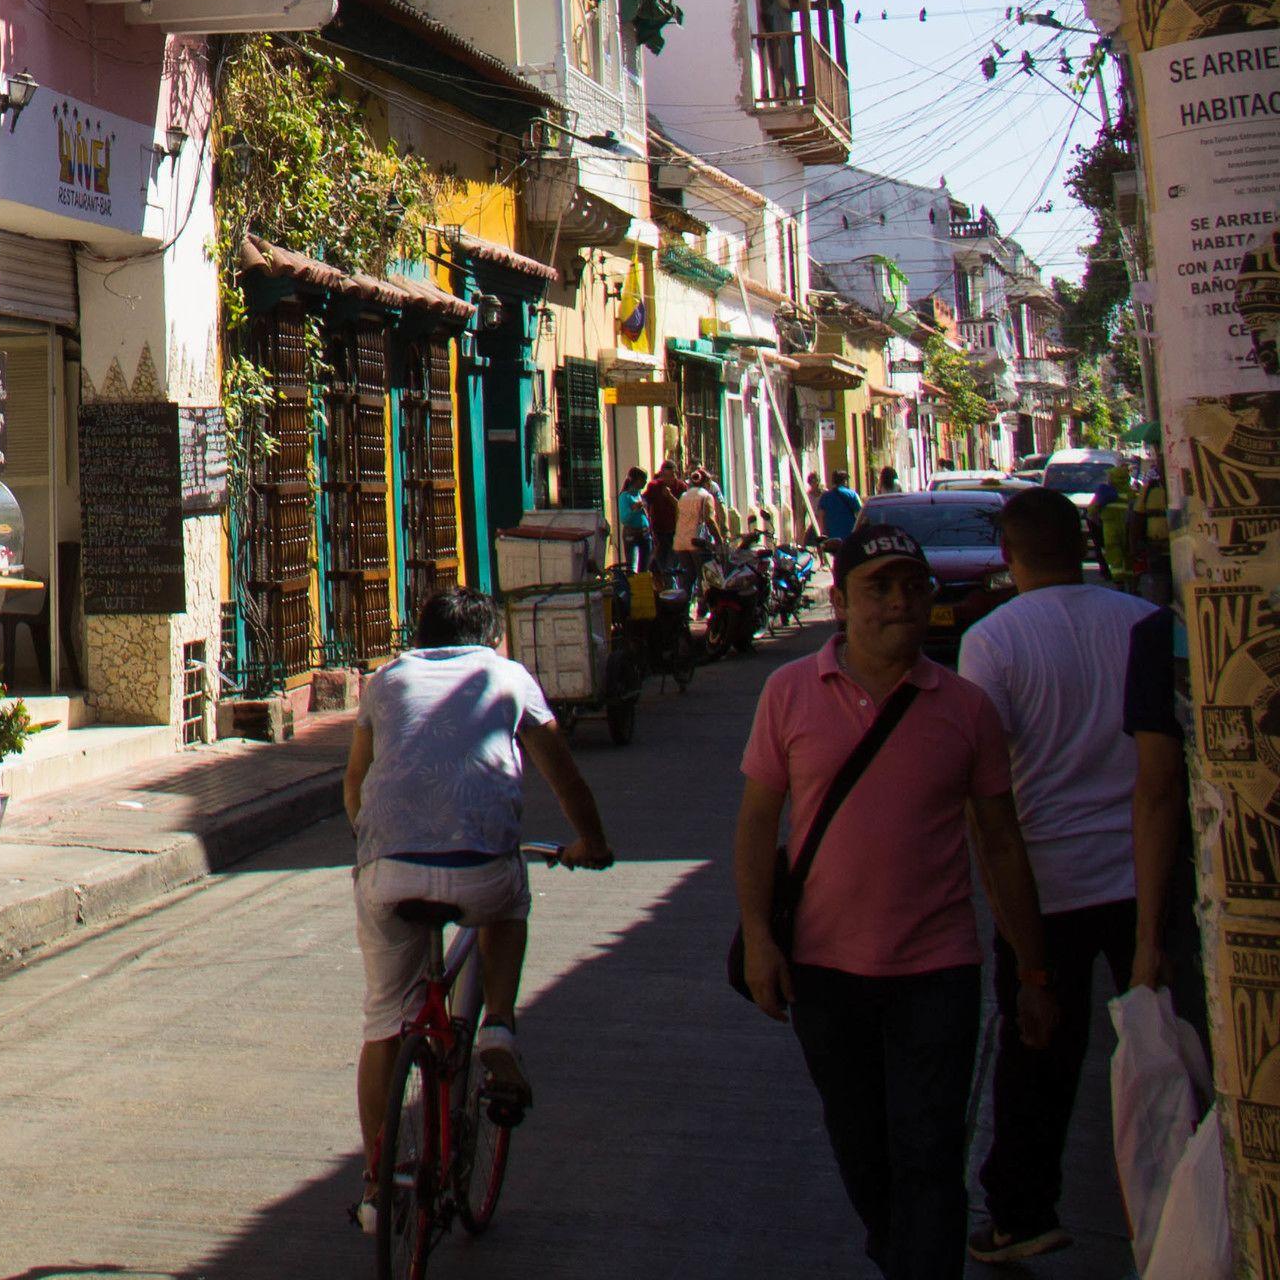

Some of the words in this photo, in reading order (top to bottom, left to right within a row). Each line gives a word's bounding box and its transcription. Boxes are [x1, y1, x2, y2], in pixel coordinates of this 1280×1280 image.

[1169, 57, 1197, 84] SE
[1191, 218, 1210, 231] SE
[1178, 261, 1206, 276] CON
[1191, 276, 1237, 295] BAÑO
